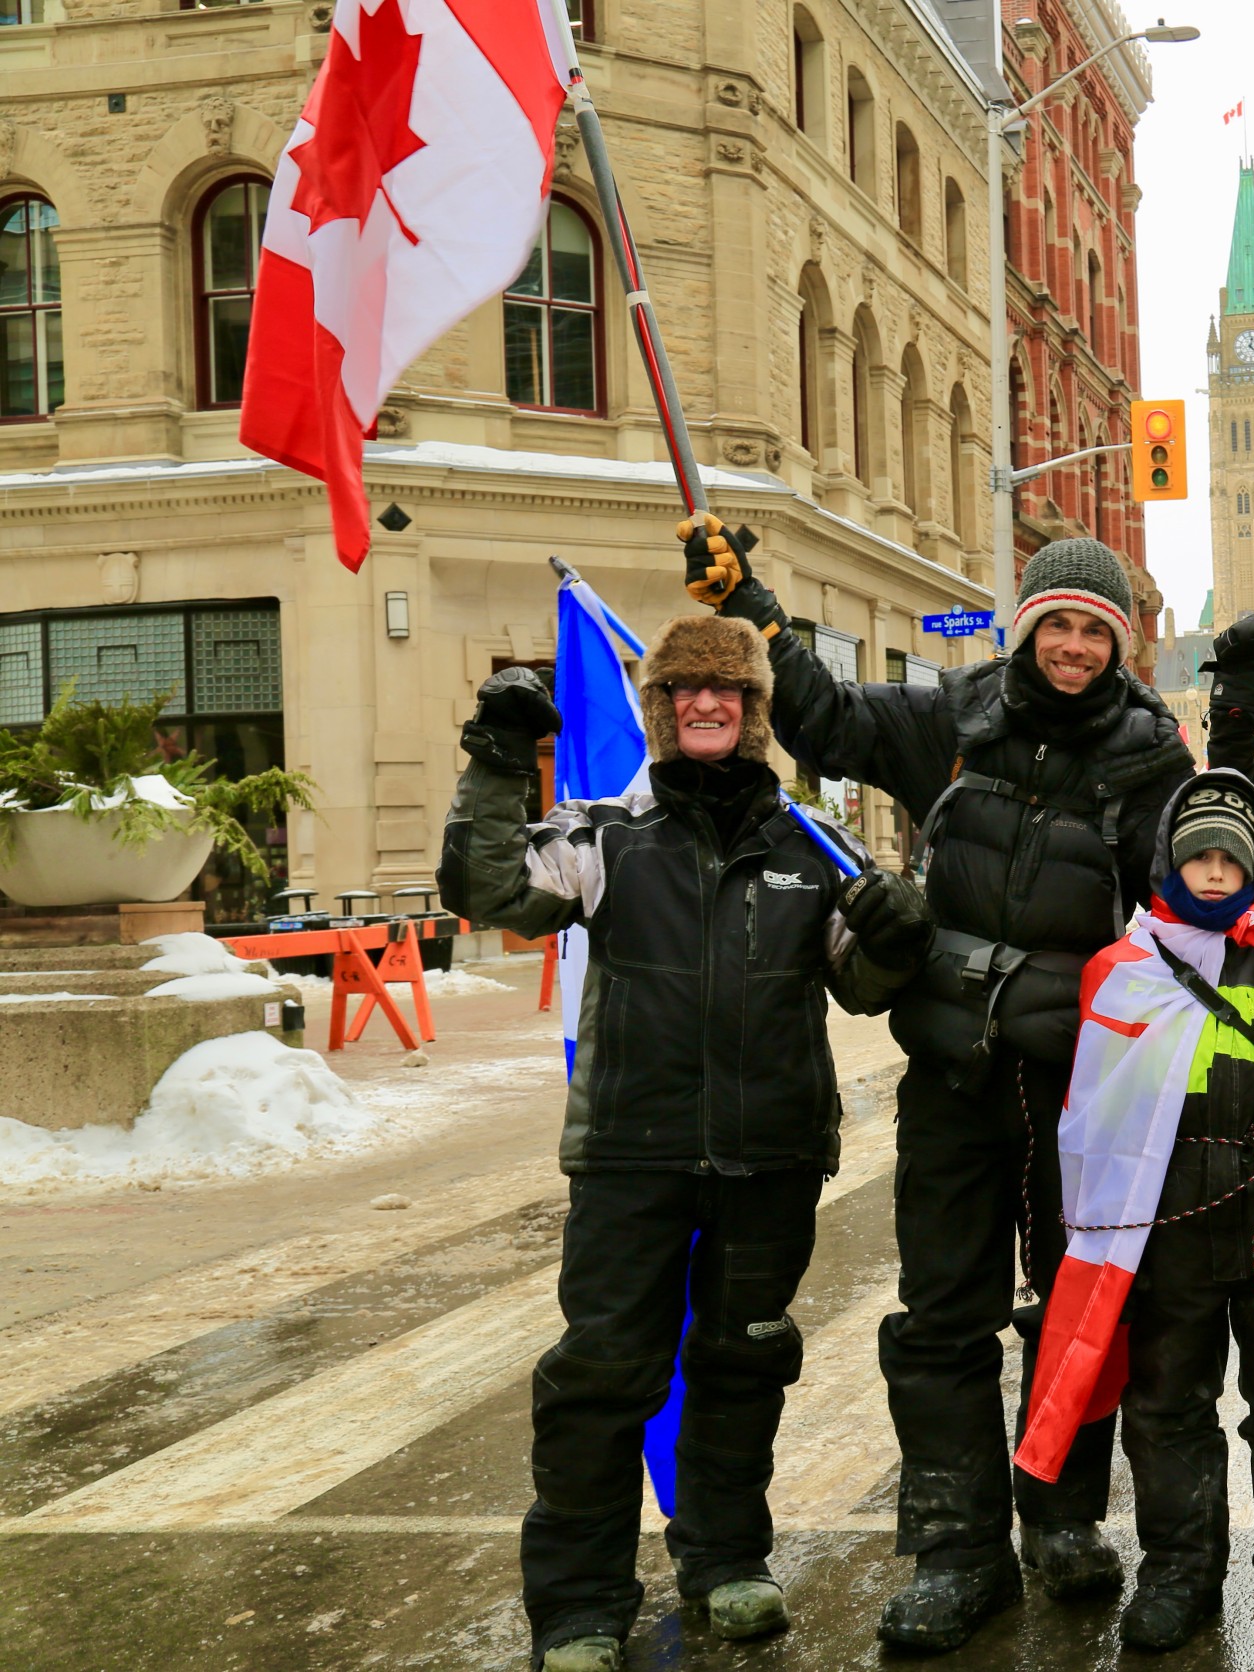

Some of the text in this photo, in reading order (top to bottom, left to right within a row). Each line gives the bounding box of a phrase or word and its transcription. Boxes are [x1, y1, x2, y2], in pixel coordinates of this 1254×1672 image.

[931, 614, 984, 630] rue Sparks St.
